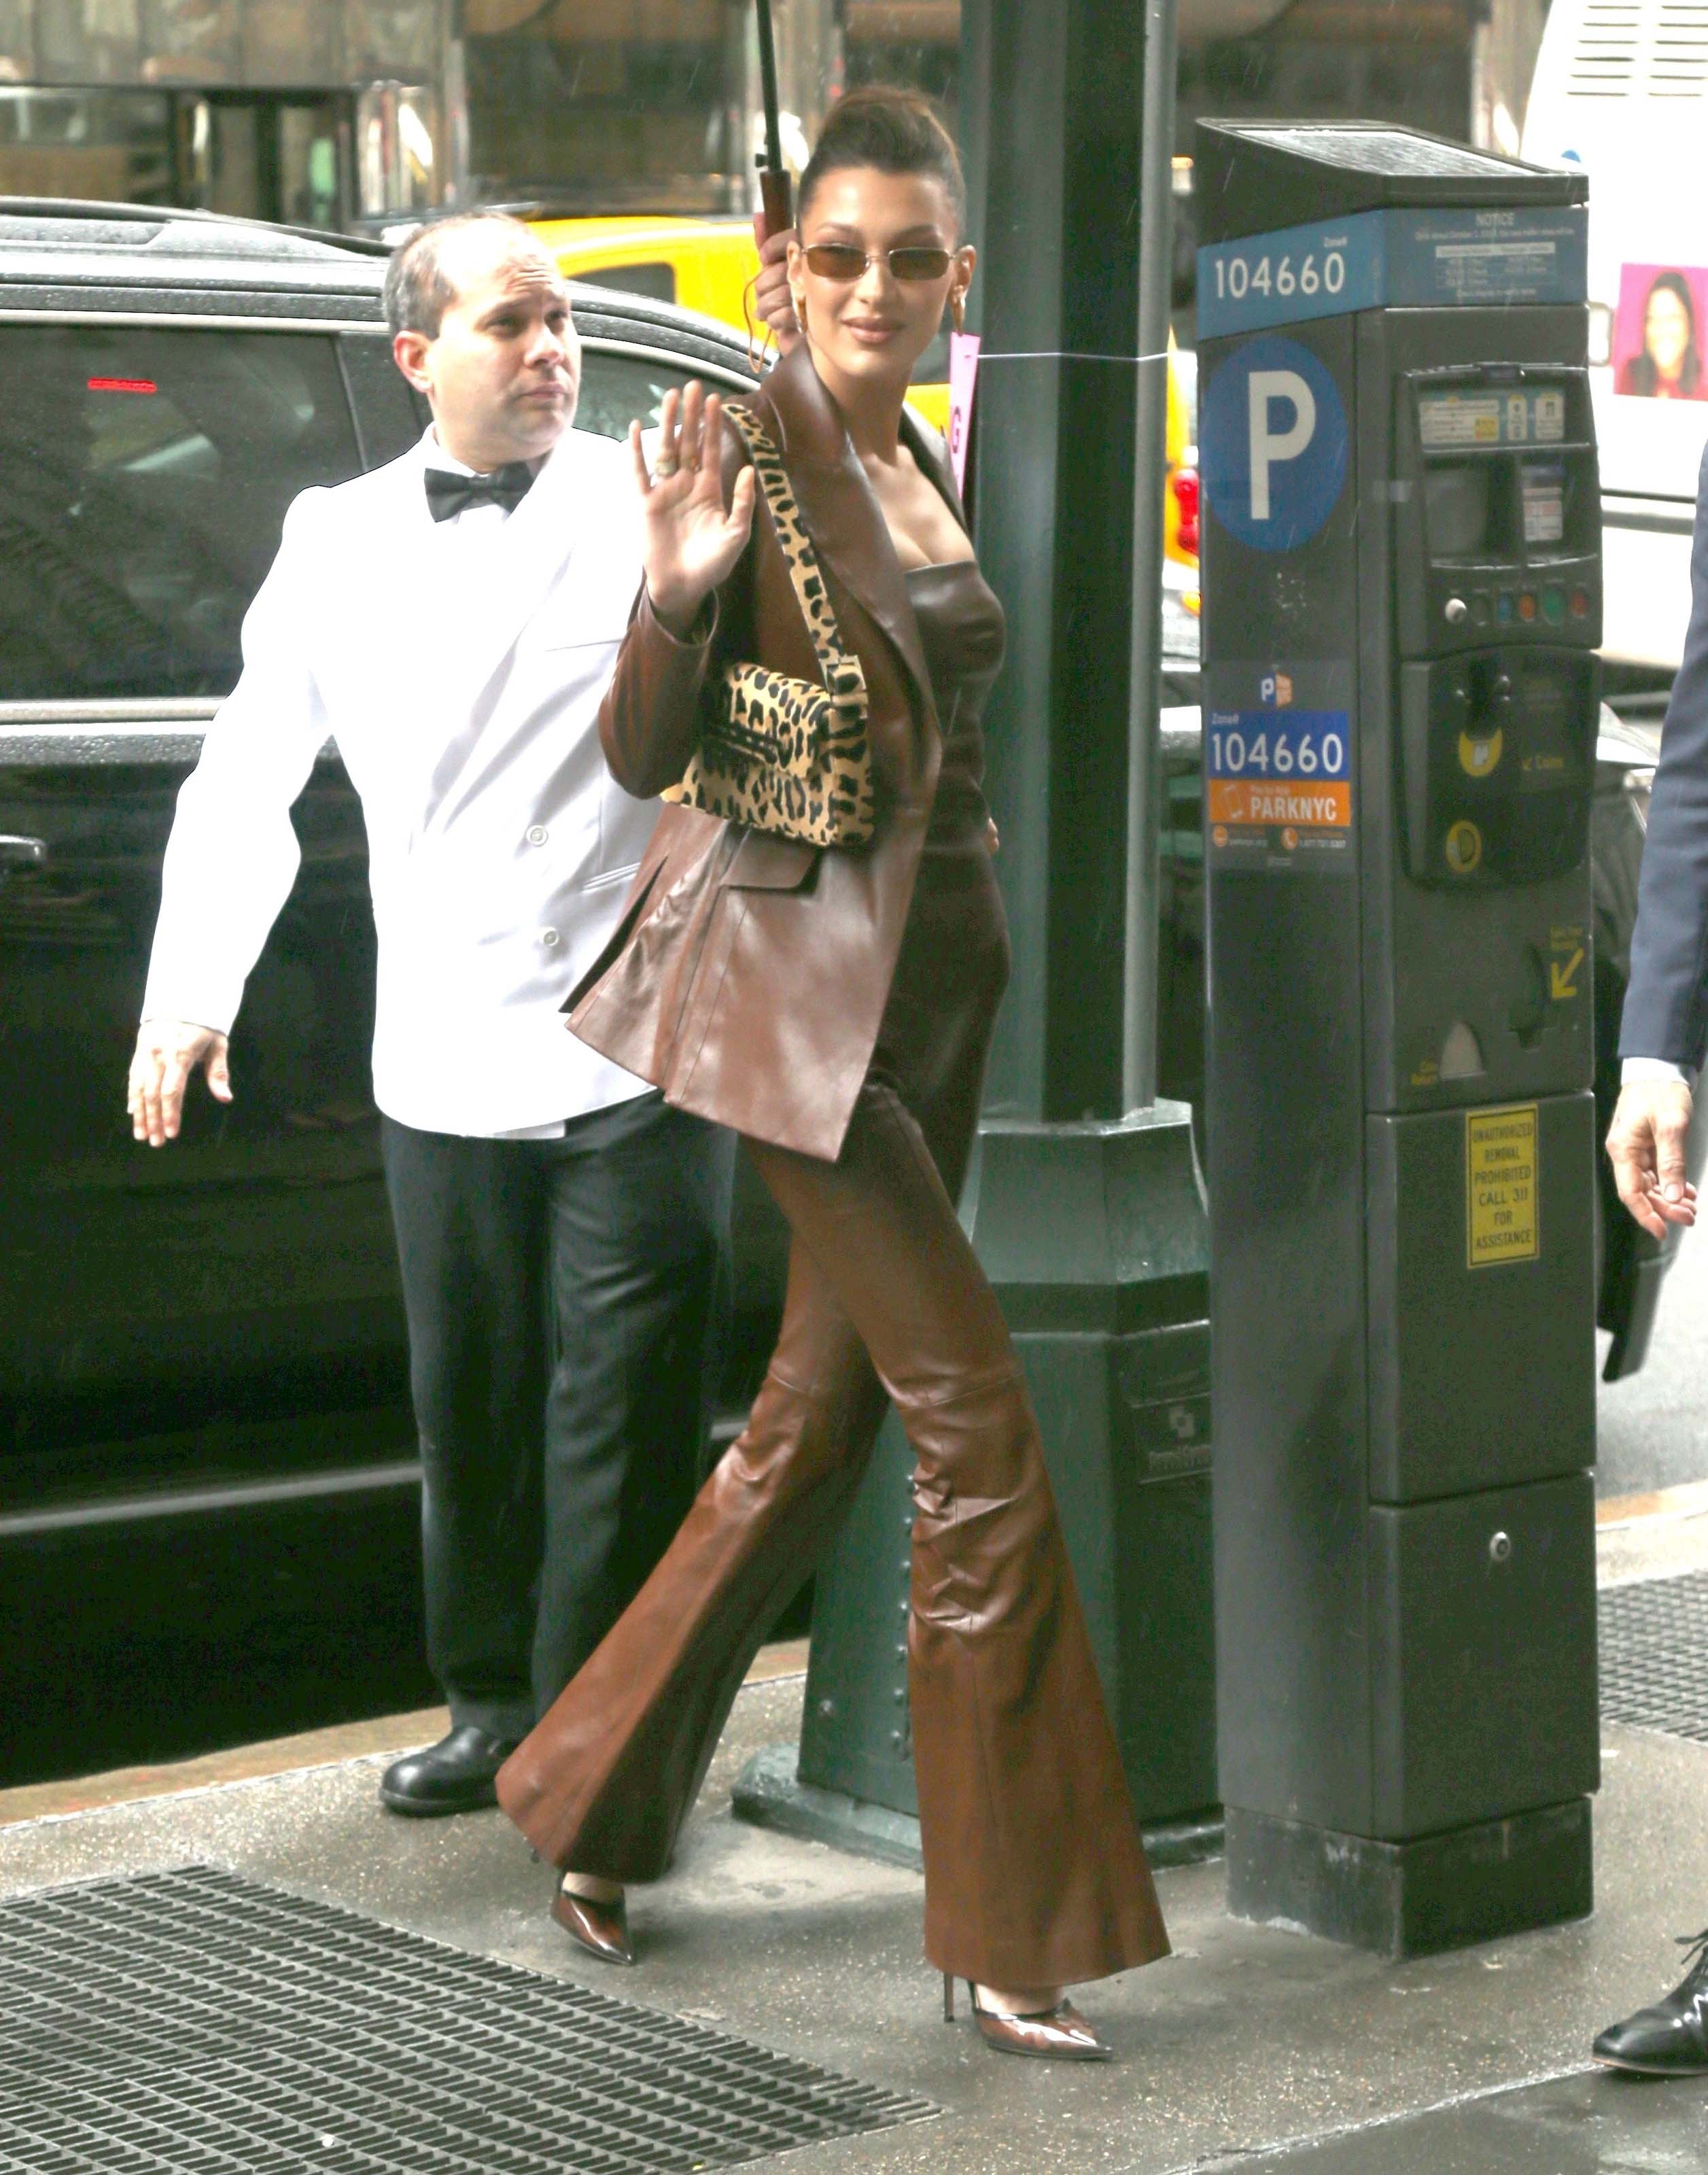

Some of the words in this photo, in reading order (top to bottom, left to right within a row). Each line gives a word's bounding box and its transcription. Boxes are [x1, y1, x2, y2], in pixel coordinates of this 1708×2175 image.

[1476, 213, 1515, 227] NOTICE
[1215, 252, 1345, 299] 104660
[1247, 370, 1317, 520] P
[1212, 732, 1343, 773] 104660
[1250, 796, 1337, 821] PARKNYC
[1474, 1123, 1533, 1143] UNAUTHORIZED
[1475, 1165, 1531, 1185] PROHIBITED
[1478, 1191, 1508, 1207] CALL
[1512, 1187, 1529, 1202] 311
[1494, 1210, 1513, 1225] FOR
[1476, 1229, 1532, 1249] ASSISTANCE
